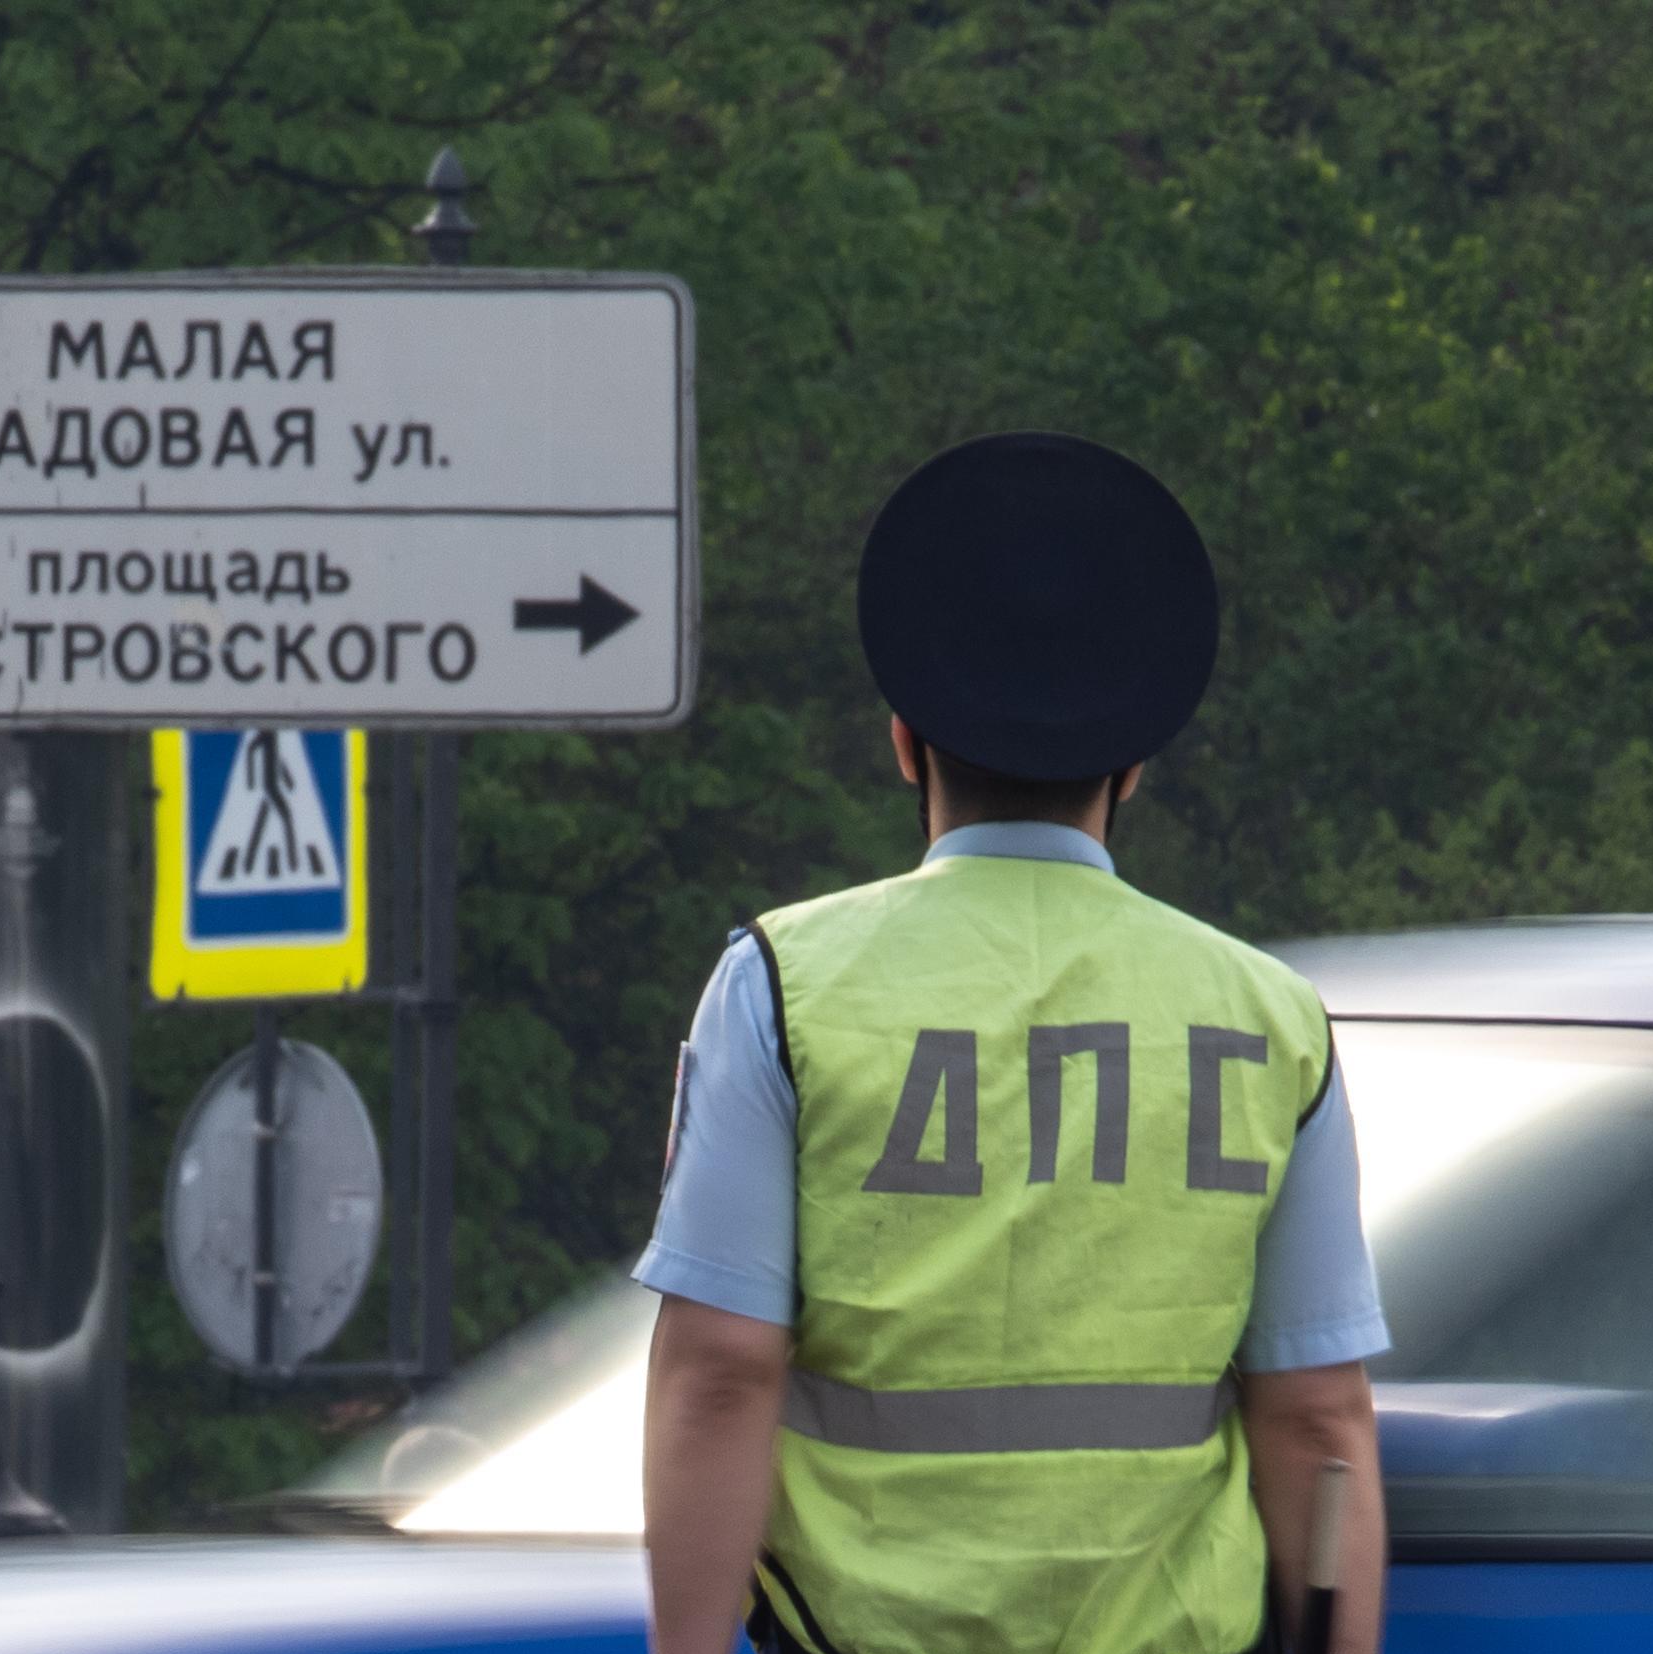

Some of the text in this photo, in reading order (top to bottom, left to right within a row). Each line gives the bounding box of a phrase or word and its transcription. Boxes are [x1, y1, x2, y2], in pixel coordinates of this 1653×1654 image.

[46, 319, 335, 382] МАЛАЯ
[350, 421, 451, 485] ул.
[27, 549, 352, 603] площадь
[860, 1021, 1269, 1196] ДПС
